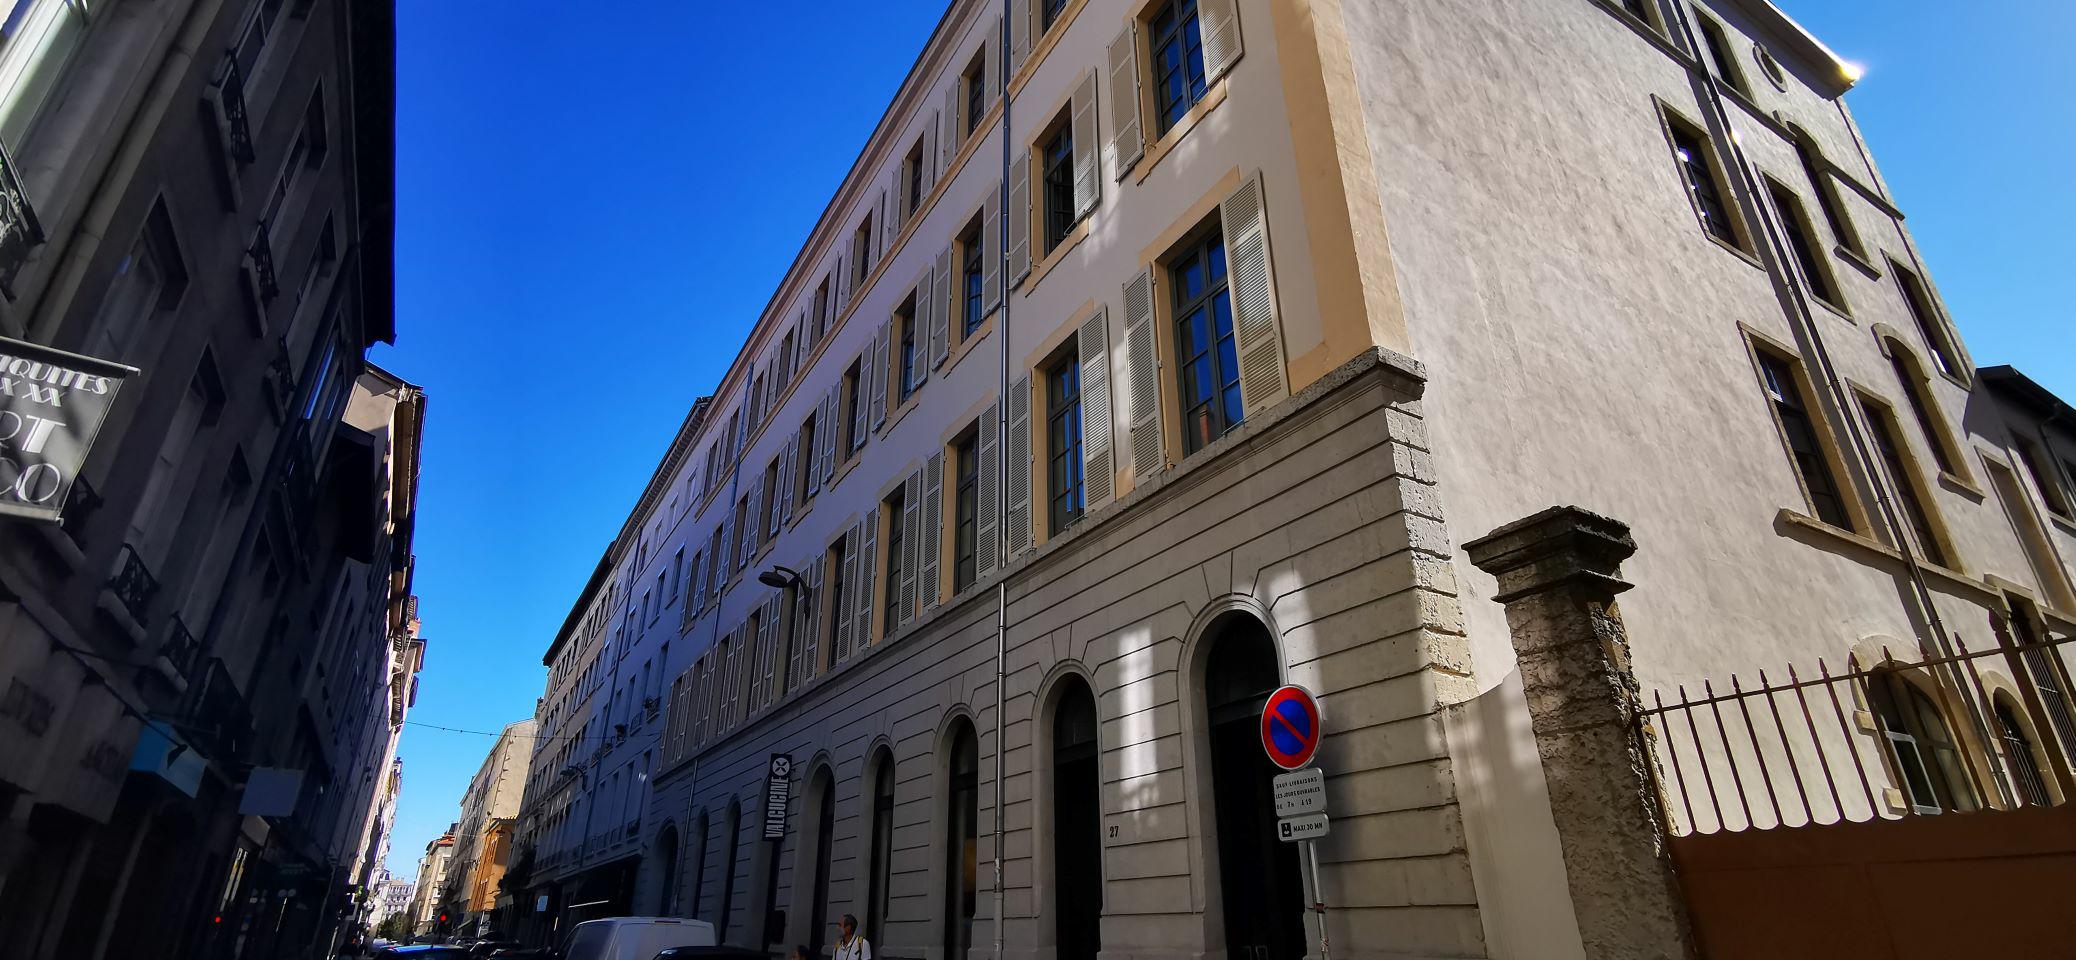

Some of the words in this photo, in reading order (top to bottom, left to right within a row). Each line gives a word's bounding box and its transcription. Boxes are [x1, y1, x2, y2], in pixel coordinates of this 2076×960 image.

[22, 382, 66, 407] XX
[765, 776, 789, 838] VALCUCINE
[1110, 825, 1119, 838] 27
